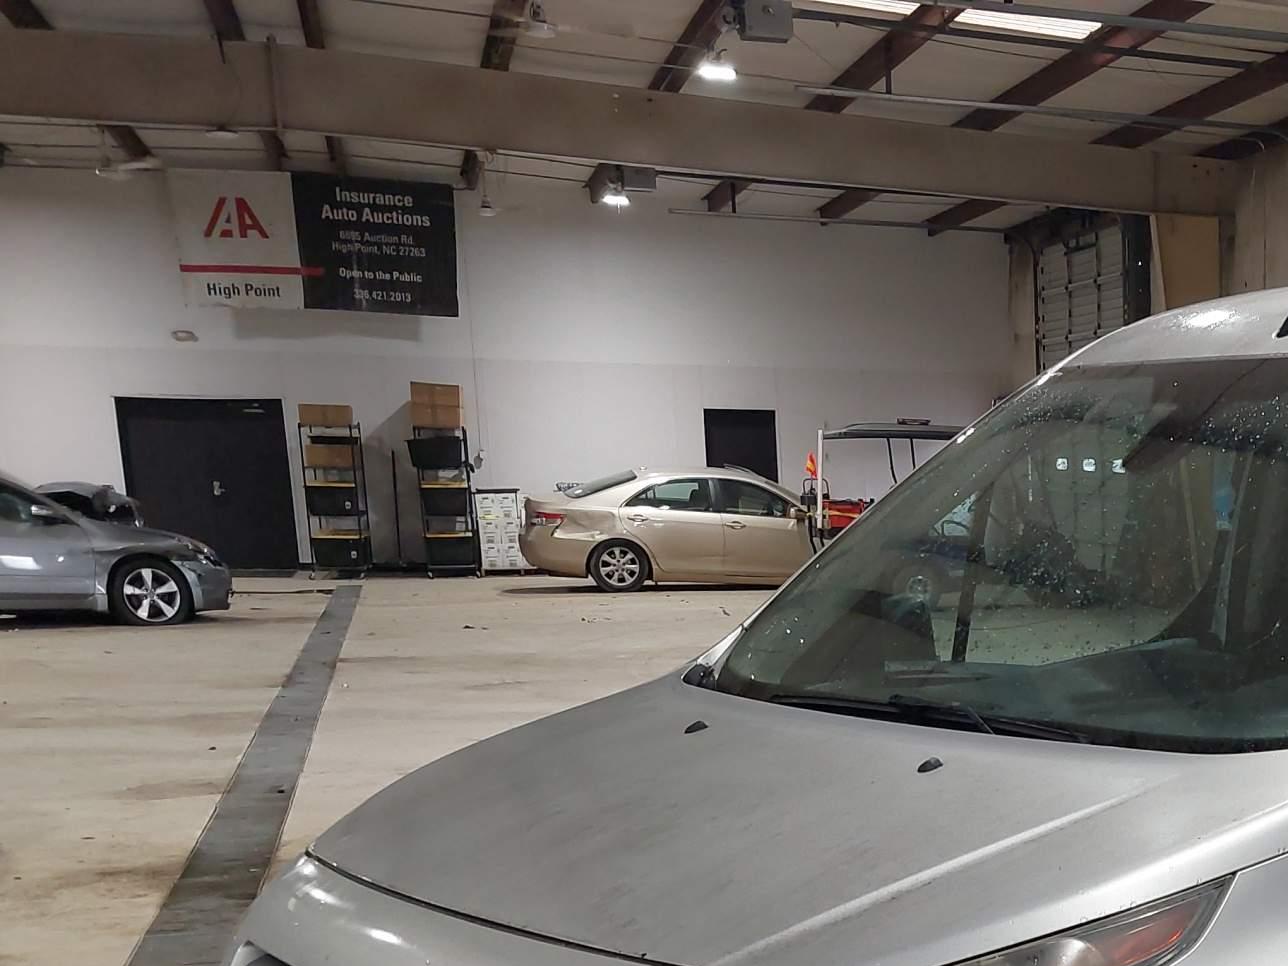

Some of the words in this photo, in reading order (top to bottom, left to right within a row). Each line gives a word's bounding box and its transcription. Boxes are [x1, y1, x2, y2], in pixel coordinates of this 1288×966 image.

[335, 186, 414, 207] Insurance
[321, 204, 357, 222] Auto
[361, 207, 431, 227] Auctions
[363, 231, 399, 244] Auction
[332, 241, 352, 253] High
[354, 242, 380, 255] Point,
[382, 245, 397, 256] NC
[399, 247, 426, 258] 27263
[339, 267, 363, 279] Open
[364, 270, 374, 279] to
[375, 271, 391, 281] the
[392, 271, 423, 283] Public
[206, 282, 240, 299] High
[244, 282, 281, 298] Point
